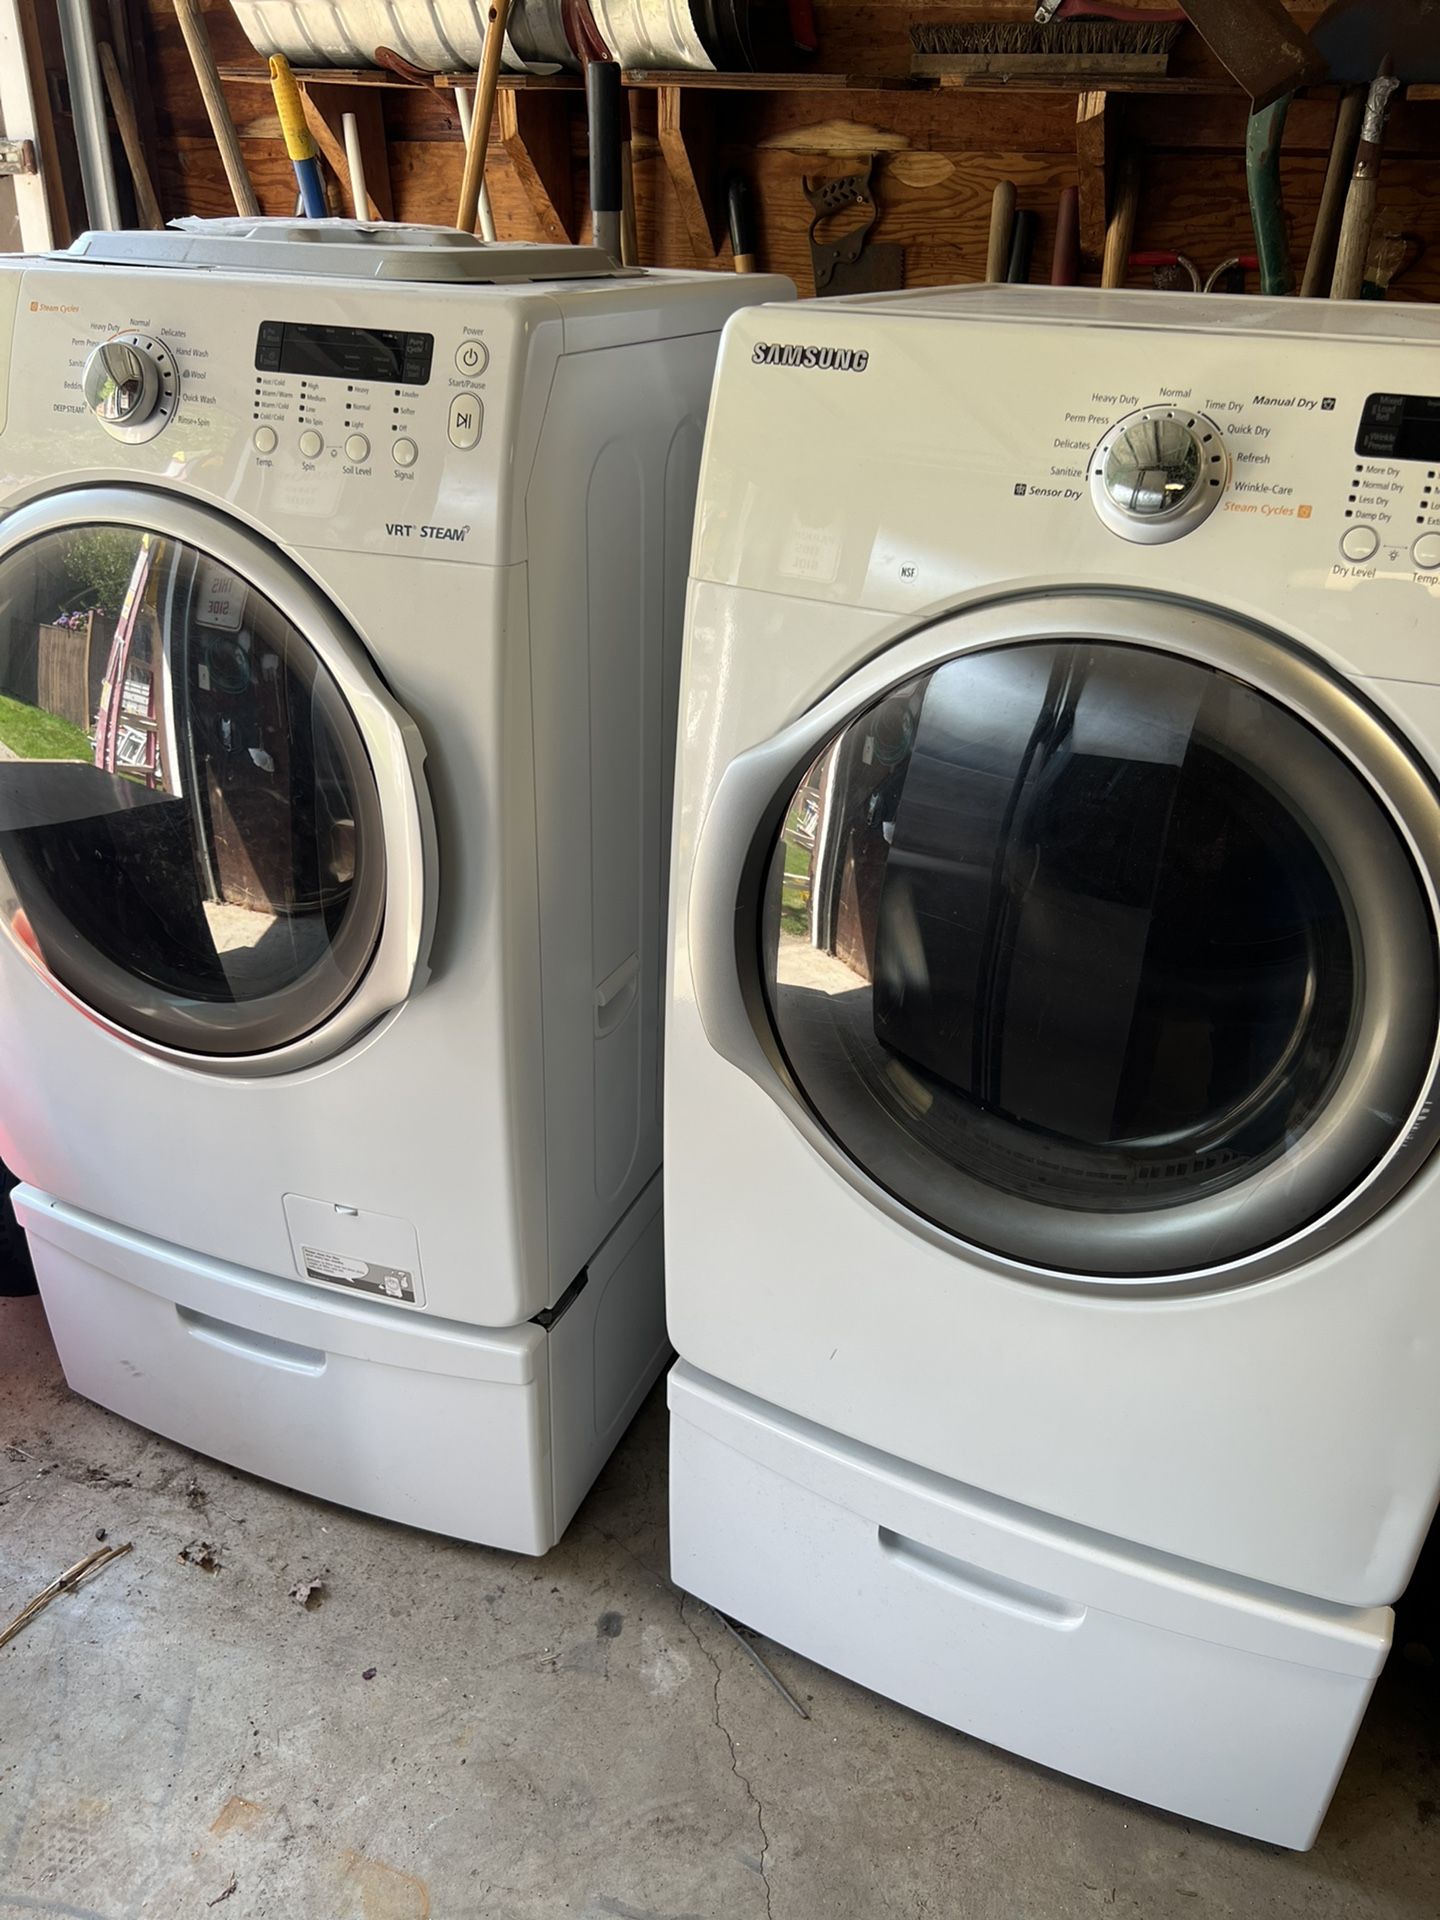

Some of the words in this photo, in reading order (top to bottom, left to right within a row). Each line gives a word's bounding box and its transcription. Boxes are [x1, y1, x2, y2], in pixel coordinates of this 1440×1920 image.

[91, 323, 106, 332] Heavy
[107, 323, 120, 333] Duty
[130, 318, 150, 327] Normal
[161, 328, 186, 338] Delicates
[462, 326, 484, 336] Power
[72, 338, 85, 346] Perm
[176, 347, 191, 356] Hand
[192, 348, 209, 358] Wash
[752, 342, 869, 372] SAMSUNG
[191, 371, 206, 379] Wool
[448, 379, 486, 390] Start/Pause
[1159, 387, 1192, 398] Normal
[183, 394, 199, 404] Quick
[200, 396, 217, 405] Wash
[1092, 393, 1117, 405] Heavy
[1119, 394, 1140, 406] Duty
[1252, 395, 1295, 408] Manual
[1297, 398, 1318, 411] Dry
[1205, 400, 1224, 410] Time
[1226, 401, 1244, 413] Dry
[1065, 412, 1086, 423] Perm
[1088, 415, 1110, 425] Press
[1227, 424, 1251, 435] Quick
[1253, 425, 1271, 438] Dry
[1053, 439, 1091, 451] Delicates
[256, 458, 273, 467] Temp.
[1237, 453, 1271, 464] Refresh
[302, 462, 316, 472] Spin
[342, 465, 354, 475] Soil
[355, 467, 372, 477] Level
[1050, 466, 1083, 478] Sanitize
[1366, 465, 1386, 476] More
[1387, 467, 1400, 480] Dry
[394, 470, 415, 481] Signal
[1029, 485, 1062, 498] Sensor
[1064, 488, 1083, 501] Dry
[1235, 481, 1294, 496] Wrinkle-Care
[1362, 480, 1389, 491] Normal
[1391, 482, 1404, 494] Dry
[1359, 496, 1375, 505] Less
[1376, 497, 1389, 508] Dry
[1431, 502, 1440, 511] Lo
[1223, 501, 1258, 514] Steam
[1260, 503, 1295, 517] Cycles
[1355, 510, 1377, 521] Damp
[1379, 512, 1392, 524] Dry
[385, 523, 412, 537] VRT
[420, 526, 465, 542] STEAM
[901, 567, 915, 578] NSF
[1333, 565, 1350, 578] Dry
[1351, 567, 1377, 579] Level
